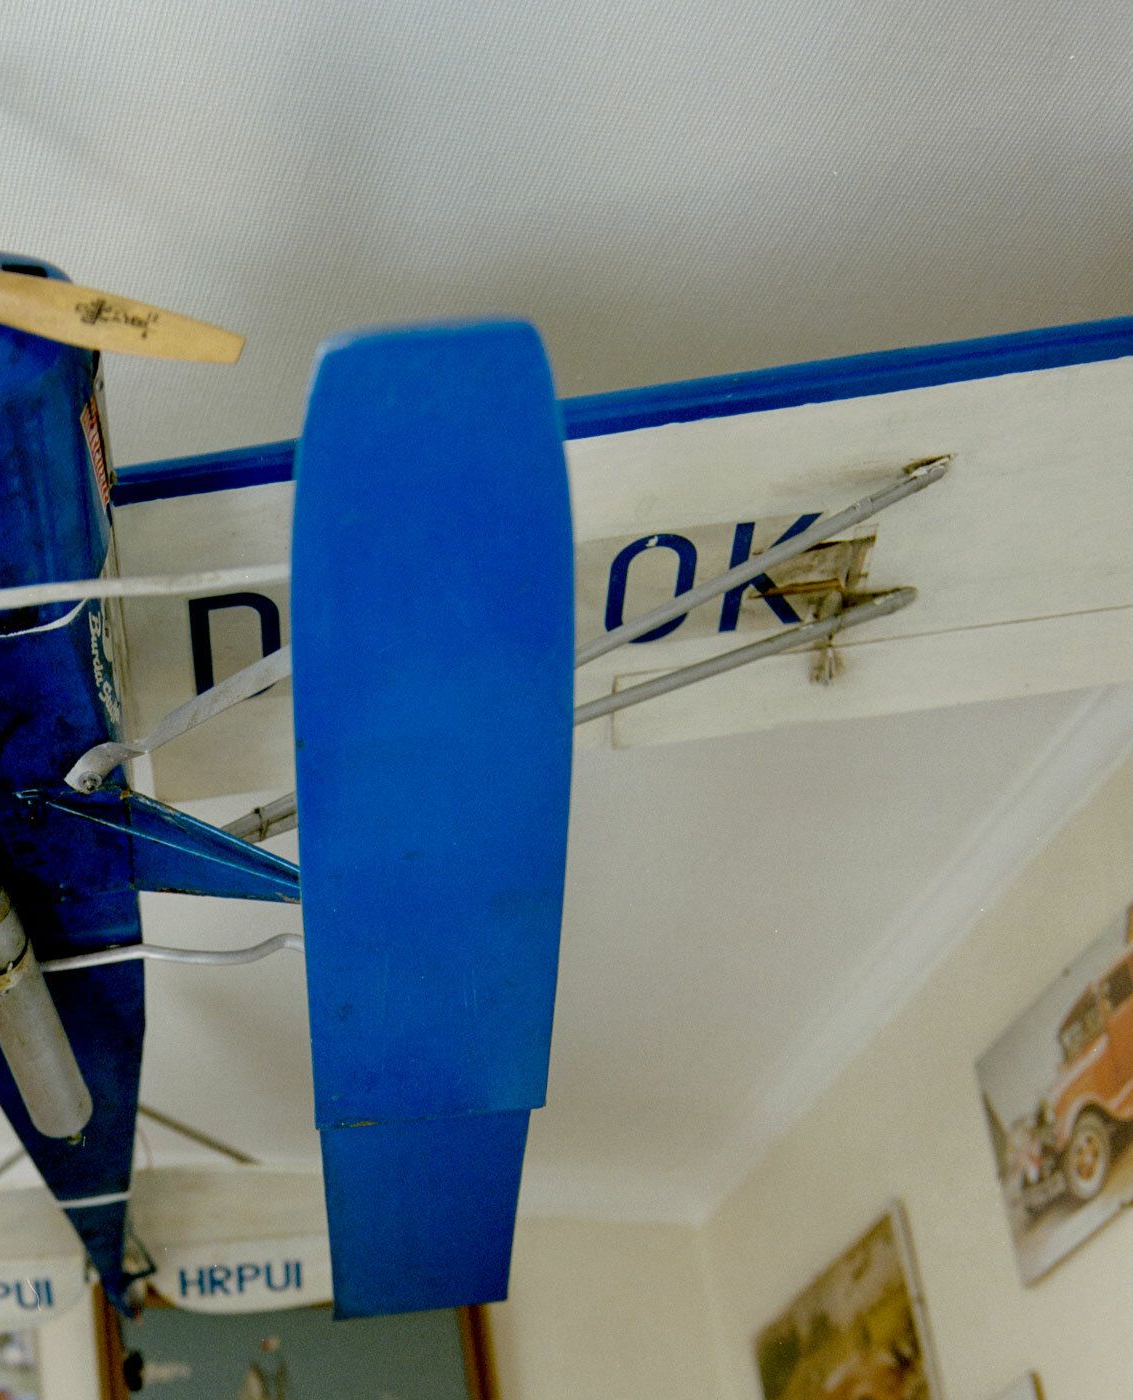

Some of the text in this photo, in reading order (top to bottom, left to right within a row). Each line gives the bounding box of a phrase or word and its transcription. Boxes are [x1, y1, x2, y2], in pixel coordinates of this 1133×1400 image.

[188, 512, 824, 698] D OK
[178, 1260, 303, 1298] HRPUI
